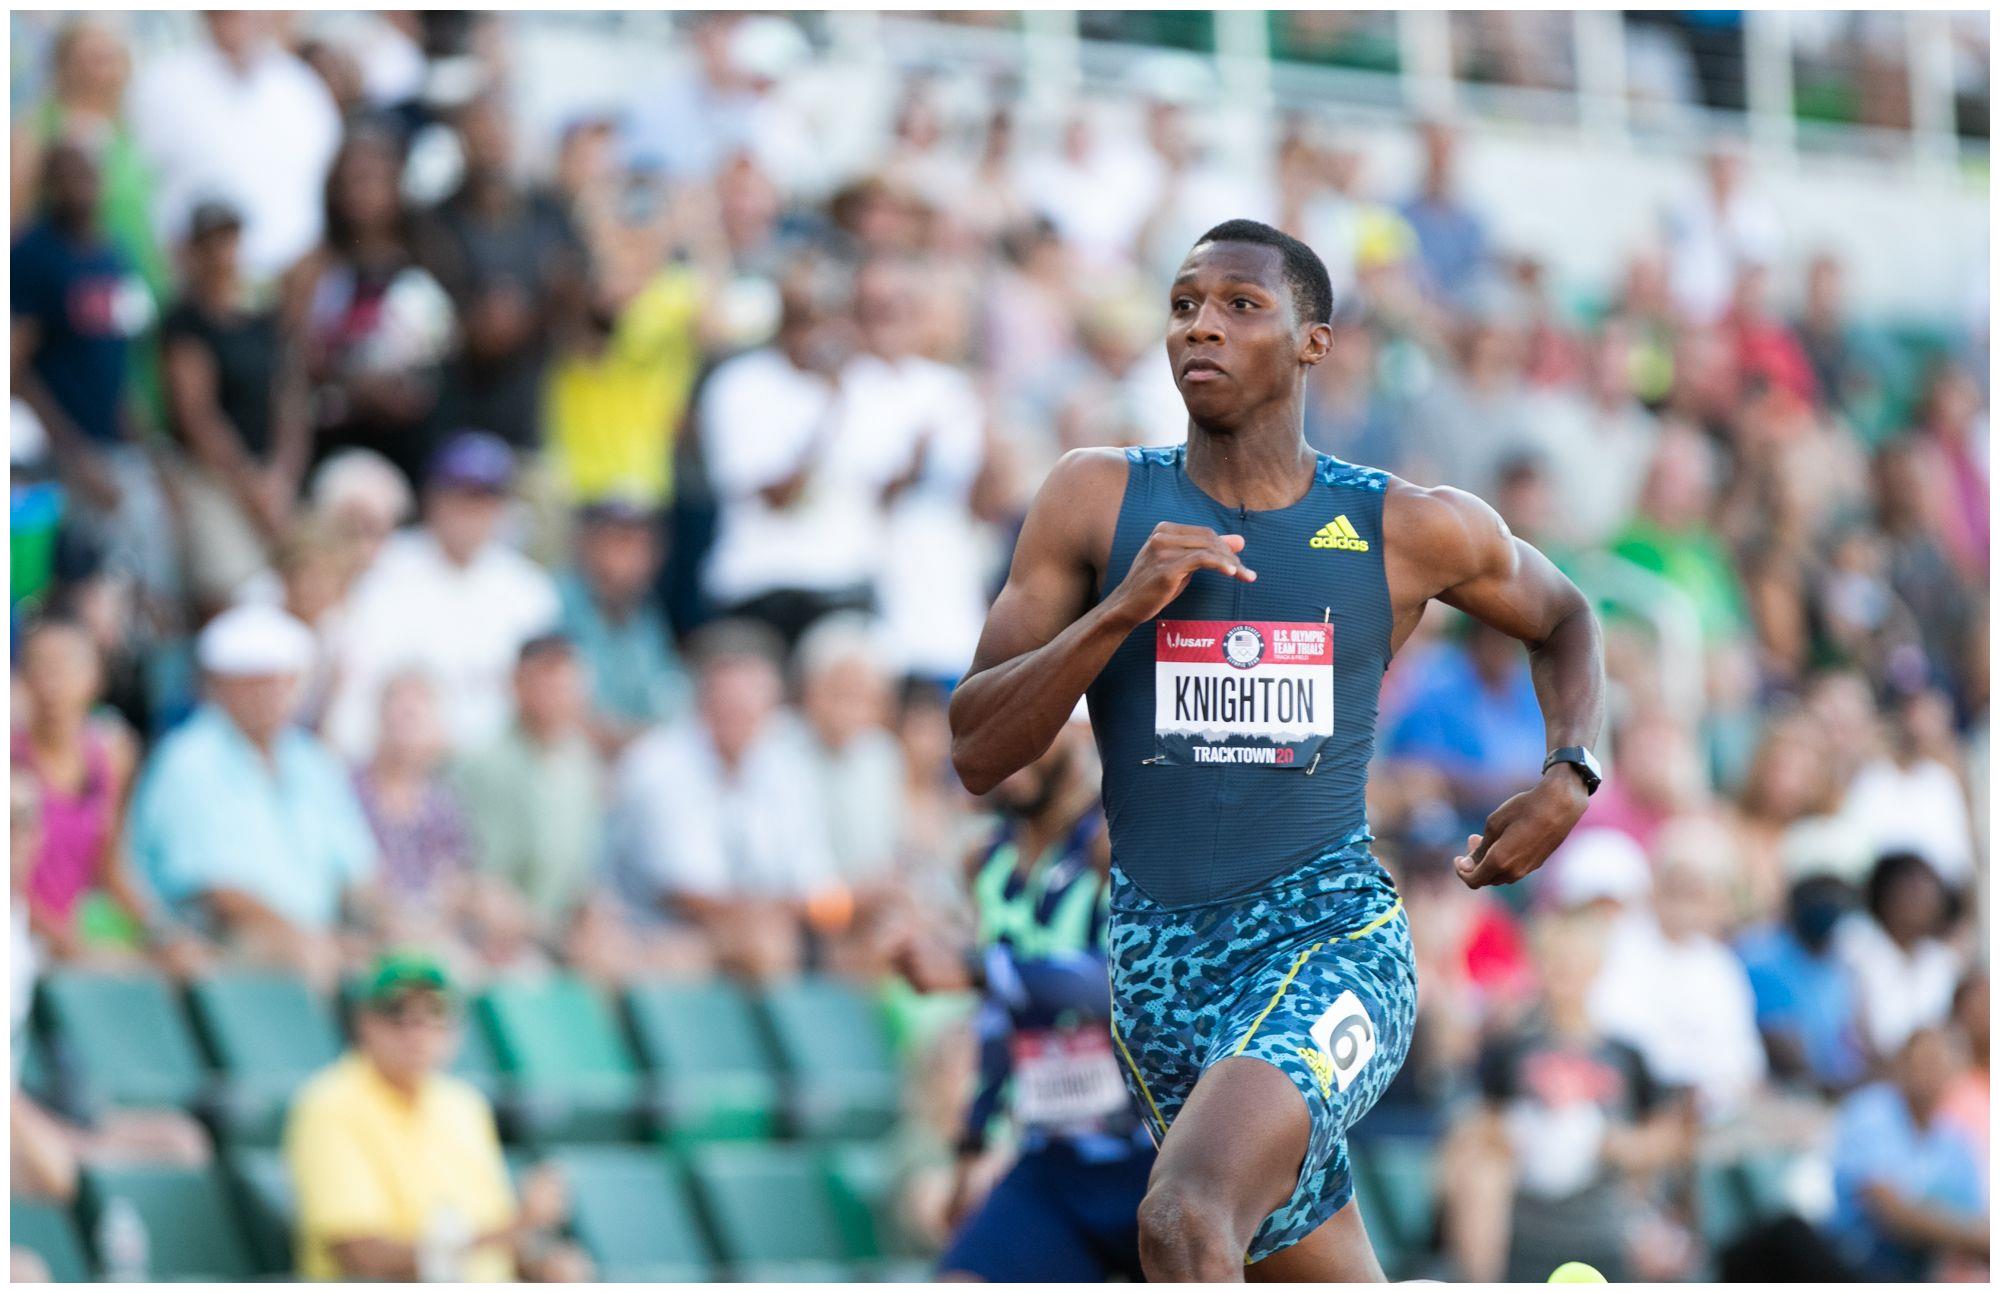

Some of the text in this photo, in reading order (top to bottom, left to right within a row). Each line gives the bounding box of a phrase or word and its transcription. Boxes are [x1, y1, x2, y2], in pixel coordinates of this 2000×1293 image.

[1309, 535, 1369, 552] adidas
[1179, 638, 1215, 648] USATF
[1273, 629, 1326, 643] U.S. OLYMPIC
[1273, 642, 1325, 656] TEAM TRIALS
[1175, 675, 1314, 724] KNIGHTON
[1329, 1014, 1371, 1071] 6
[1296, 1047, 1332, 1099] adidas
